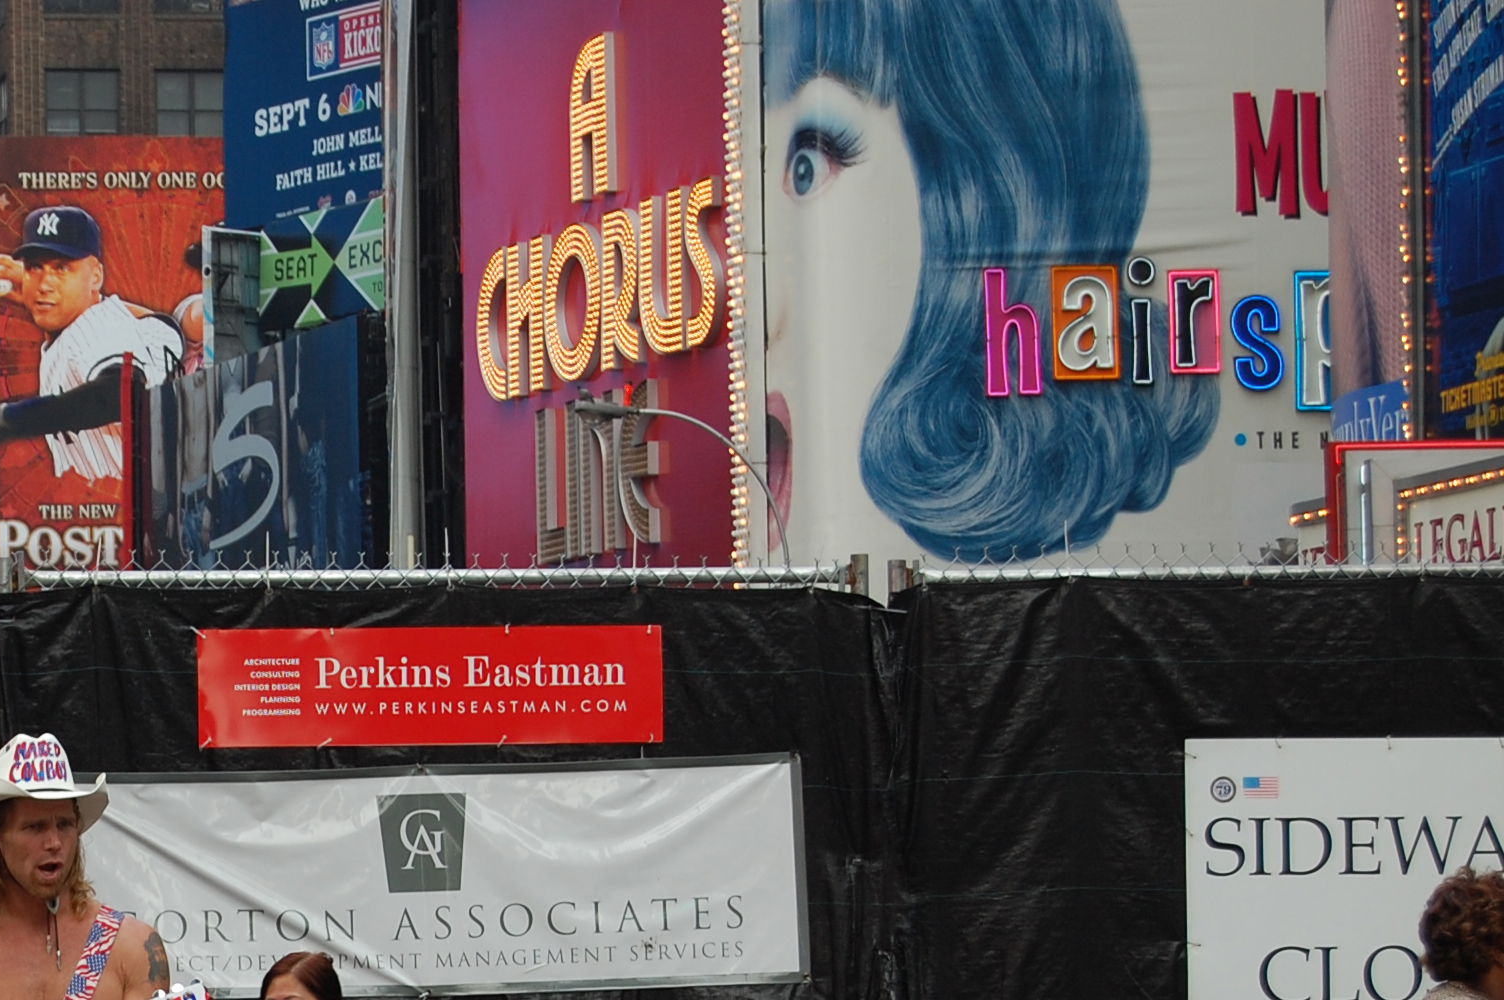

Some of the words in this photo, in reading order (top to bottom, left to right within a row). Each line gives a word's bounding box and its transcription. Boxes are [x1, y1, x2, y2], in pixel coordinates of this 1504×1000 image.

[254, 98, 310, 137] SEPT
[317, 93, 331, 121] 6
[570, 31, 613, 203] A
[312, 133, 344, 156] JOHN
[18, 171, 98, 189] THERE'S
[103, 171, 151, 189] ONLY
[157, 171, 197, 189] ONE
[276, 166, 312, 191] FAITH
[316, 160, 345, 181] HILL
[274, 253, 318, 281] SEAT
[476, 176, 720, 402] CHORUS
[1256, 431, 1300, 449] THE
[534, 377, 661, 565] LINE
[39, 504, 73, 520] THE
[79, 503, 118, 518] NEW
[243, 658, 301, 666] ARCHITECTURE
[250, 670, 301, 679] CONSULTING
[314, 655, 452, 690] Perkins
[463, 655, 626, 689] Eastman
[234, 683, 270, 691] INTERIOR
[271, 683, 301, 691] DESIGN
[315, 698, 629, 716] WWW.PERKINSEASTMAN.COM
[121, 908, 356, 944] ORTON
[393, 895, 745, 942] ASSOCIATES
[435, 945, 617, 970] MANAGEMENT
[629, 940, 745, 962] SERVICES
